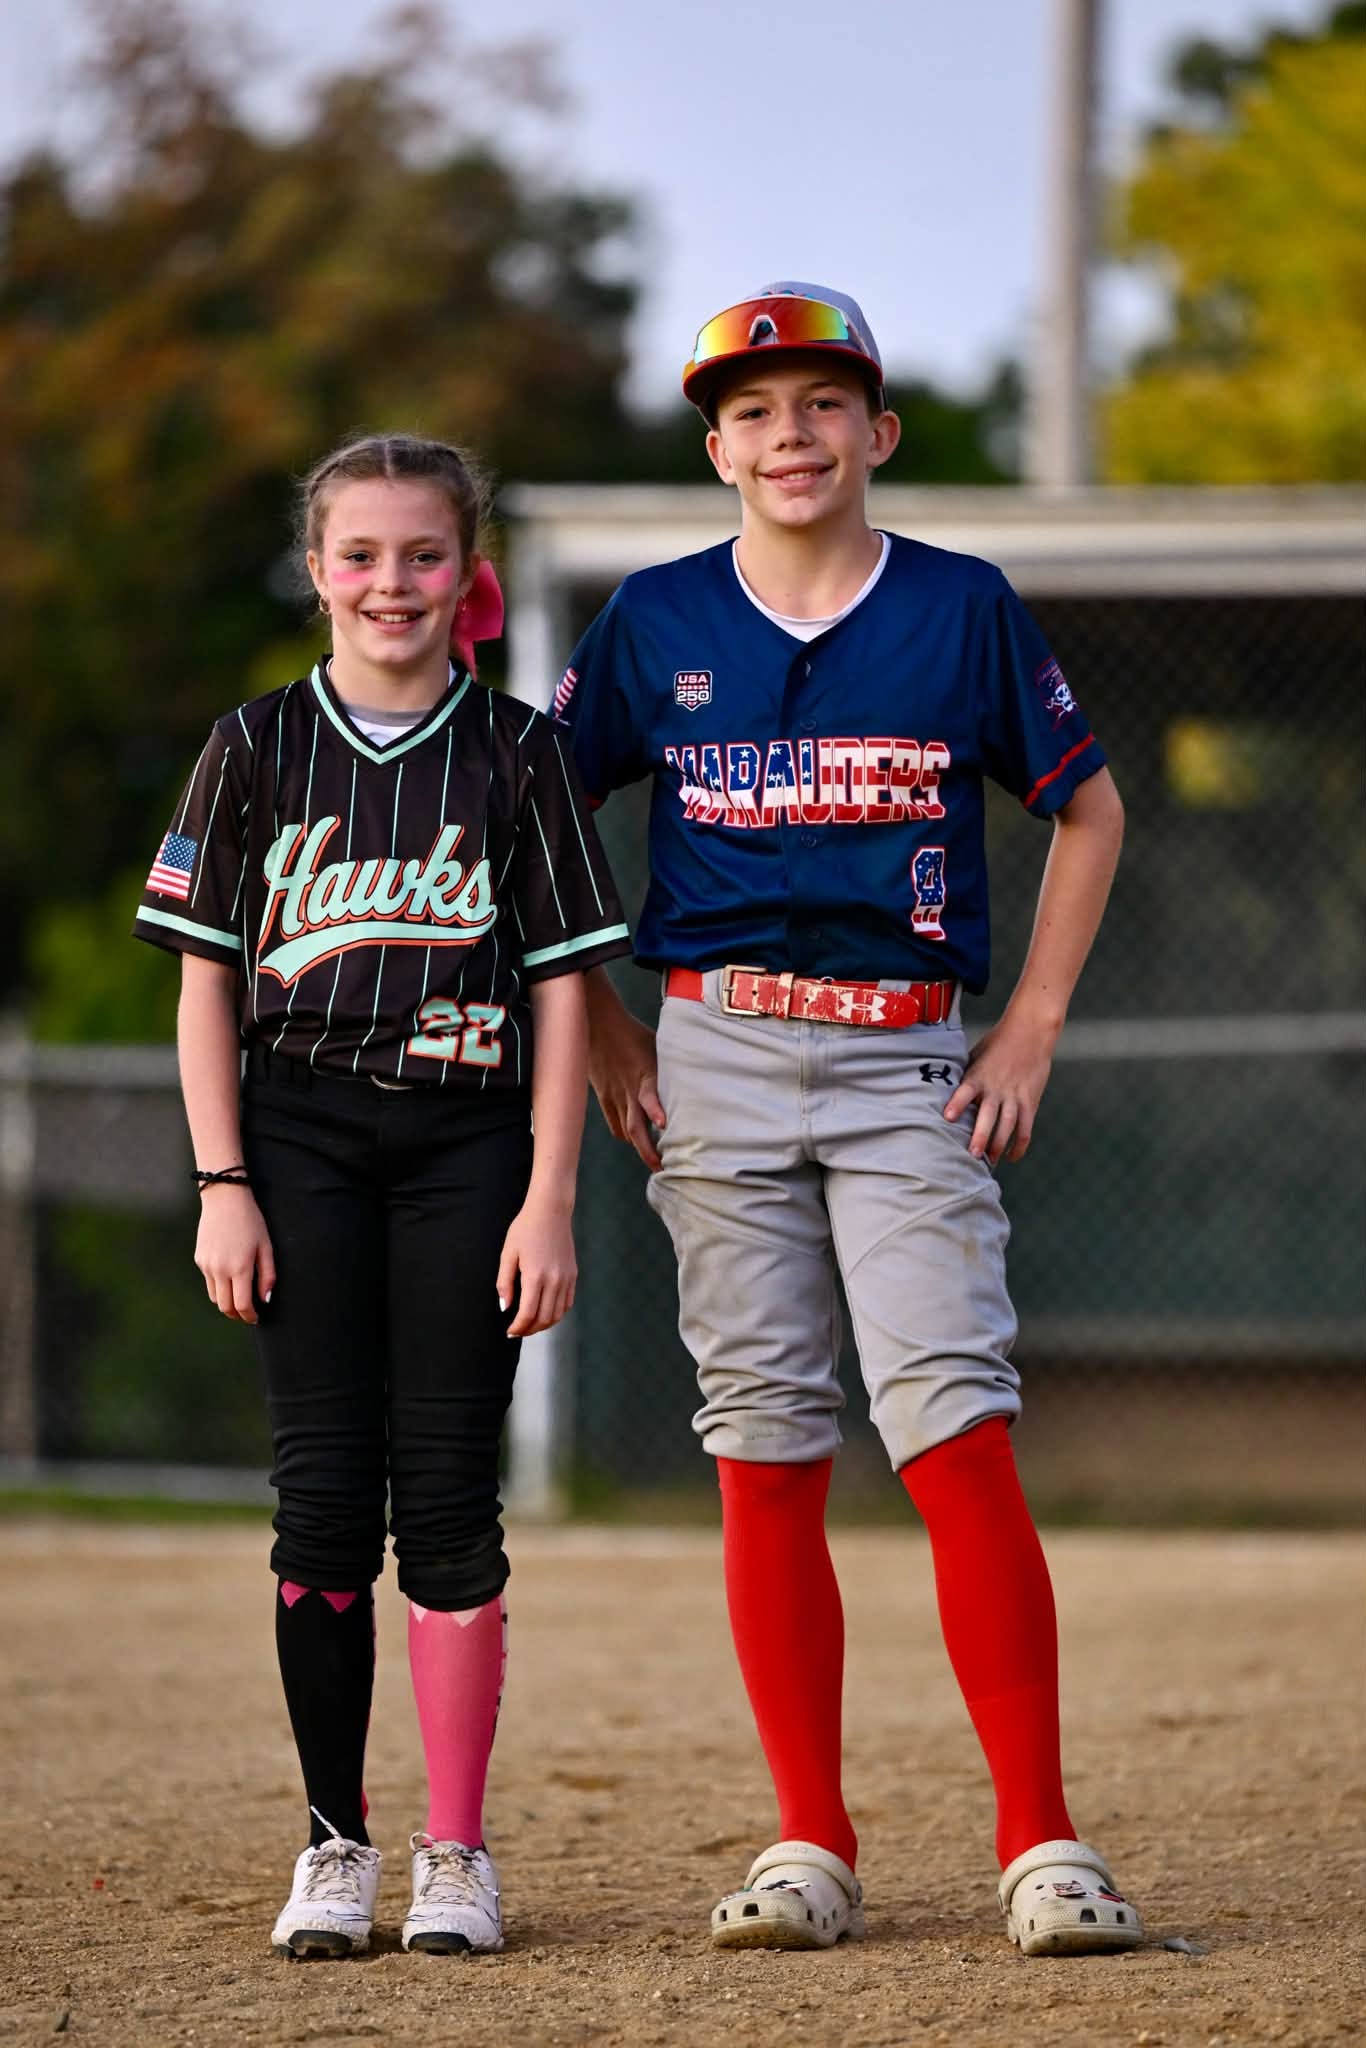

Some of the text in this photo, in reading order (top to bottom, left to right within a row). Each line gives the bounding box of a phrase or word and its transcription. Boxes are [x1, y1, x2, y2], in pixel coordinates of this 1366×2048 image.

[677, 690, 710, 702] 250
[678, 674, 708, 684] USA
[664, 737, 950, 829] MARAUDERS
[256, 815, 498, 953] Hawks
[407, 996, 505, 1068] 22
